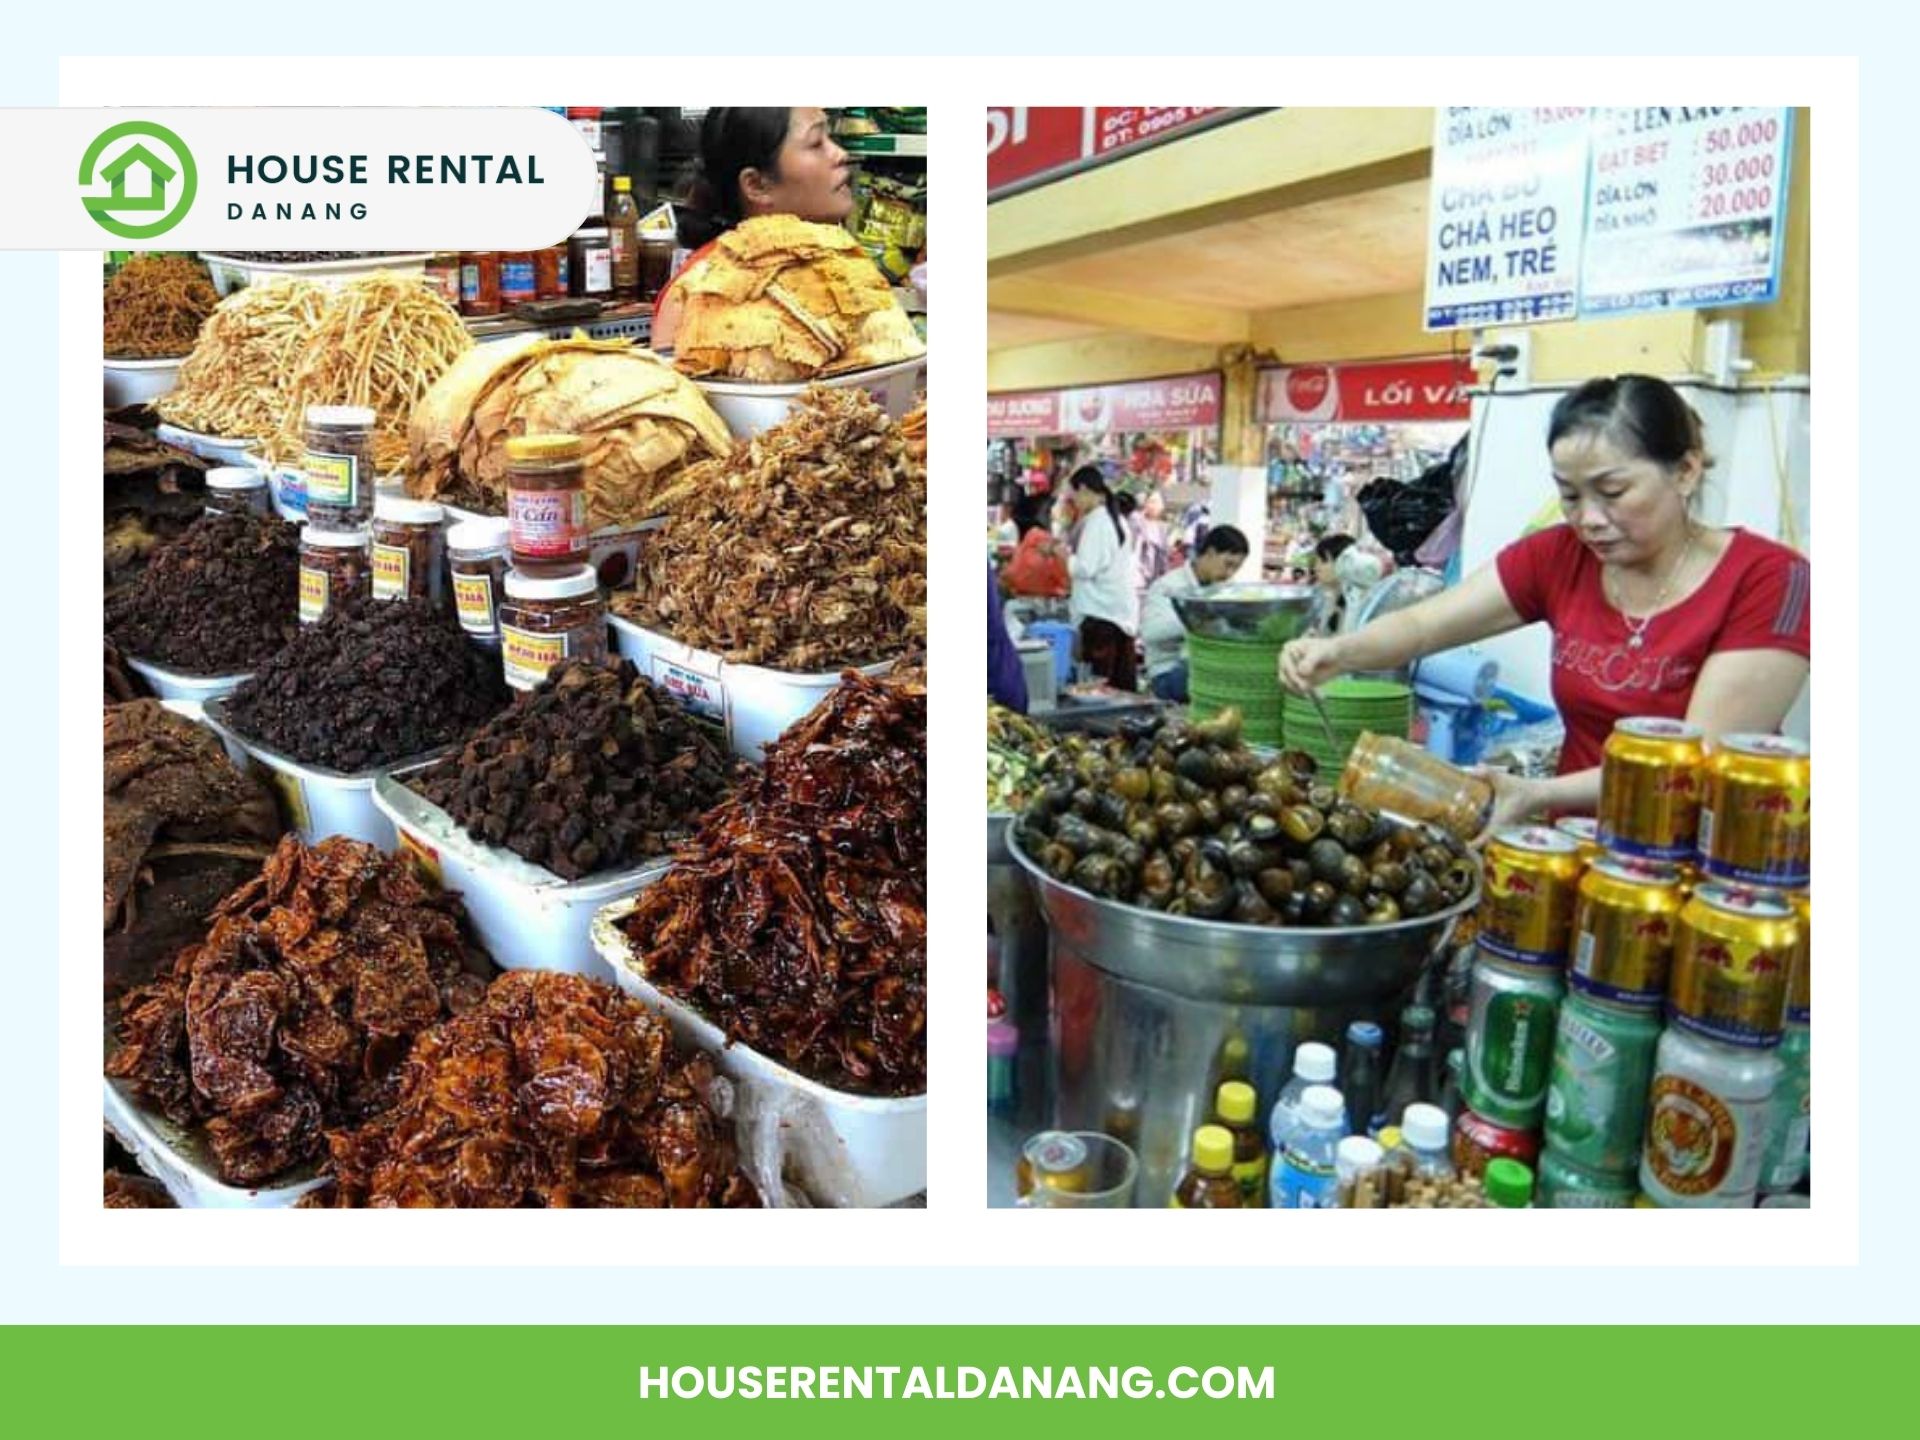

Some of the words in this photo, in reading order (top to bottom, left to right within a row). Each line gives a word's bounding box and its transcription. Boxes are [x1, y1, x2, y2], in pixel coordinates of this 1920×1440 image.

[1705, 118, 1778, 153] 50.000
[1702, 154, 1775, 188] 30.000
[1700, 185, 1772, 218] 20.000
[1500, 206, 1557, 241] HEO
[1438, 254, 1498, 288] NEM,
[1364, 380, 1413, 406] LỐI
